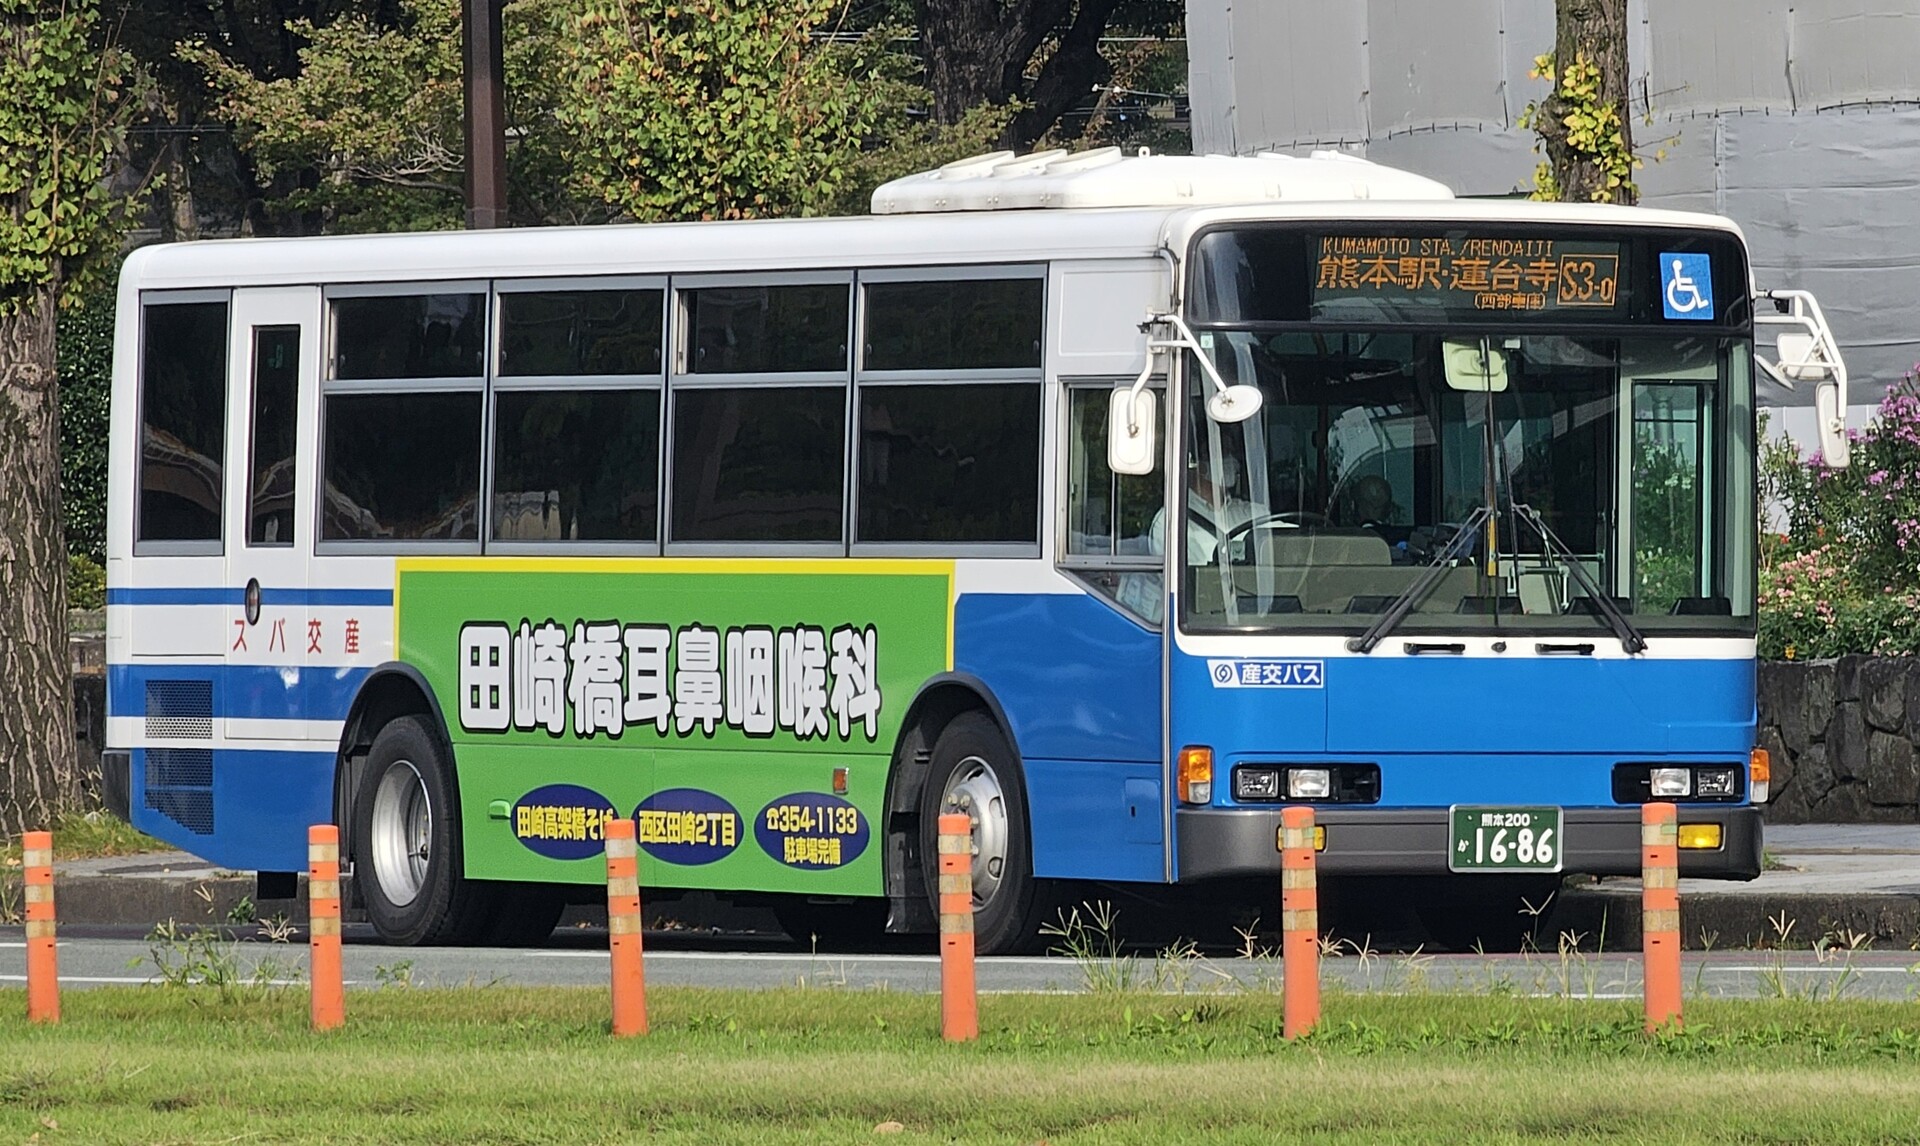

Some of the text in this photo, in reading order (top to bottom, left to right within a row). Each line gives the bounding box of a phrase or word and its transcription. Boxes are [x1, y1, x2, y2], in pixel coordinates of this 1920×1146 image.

[1323, 237, 1410, 254] KUMAMOTO
[460, 617, 882, 742] 田崎橋耳鼻咽喉科
[1241, 663, 1320, 684] 産交バス
[638, 809, 736, 847] 西区田崎2丁目
[784, 836, 841, 865] 駐車場完備
[1475, 828, 1554, 864] 16-86
